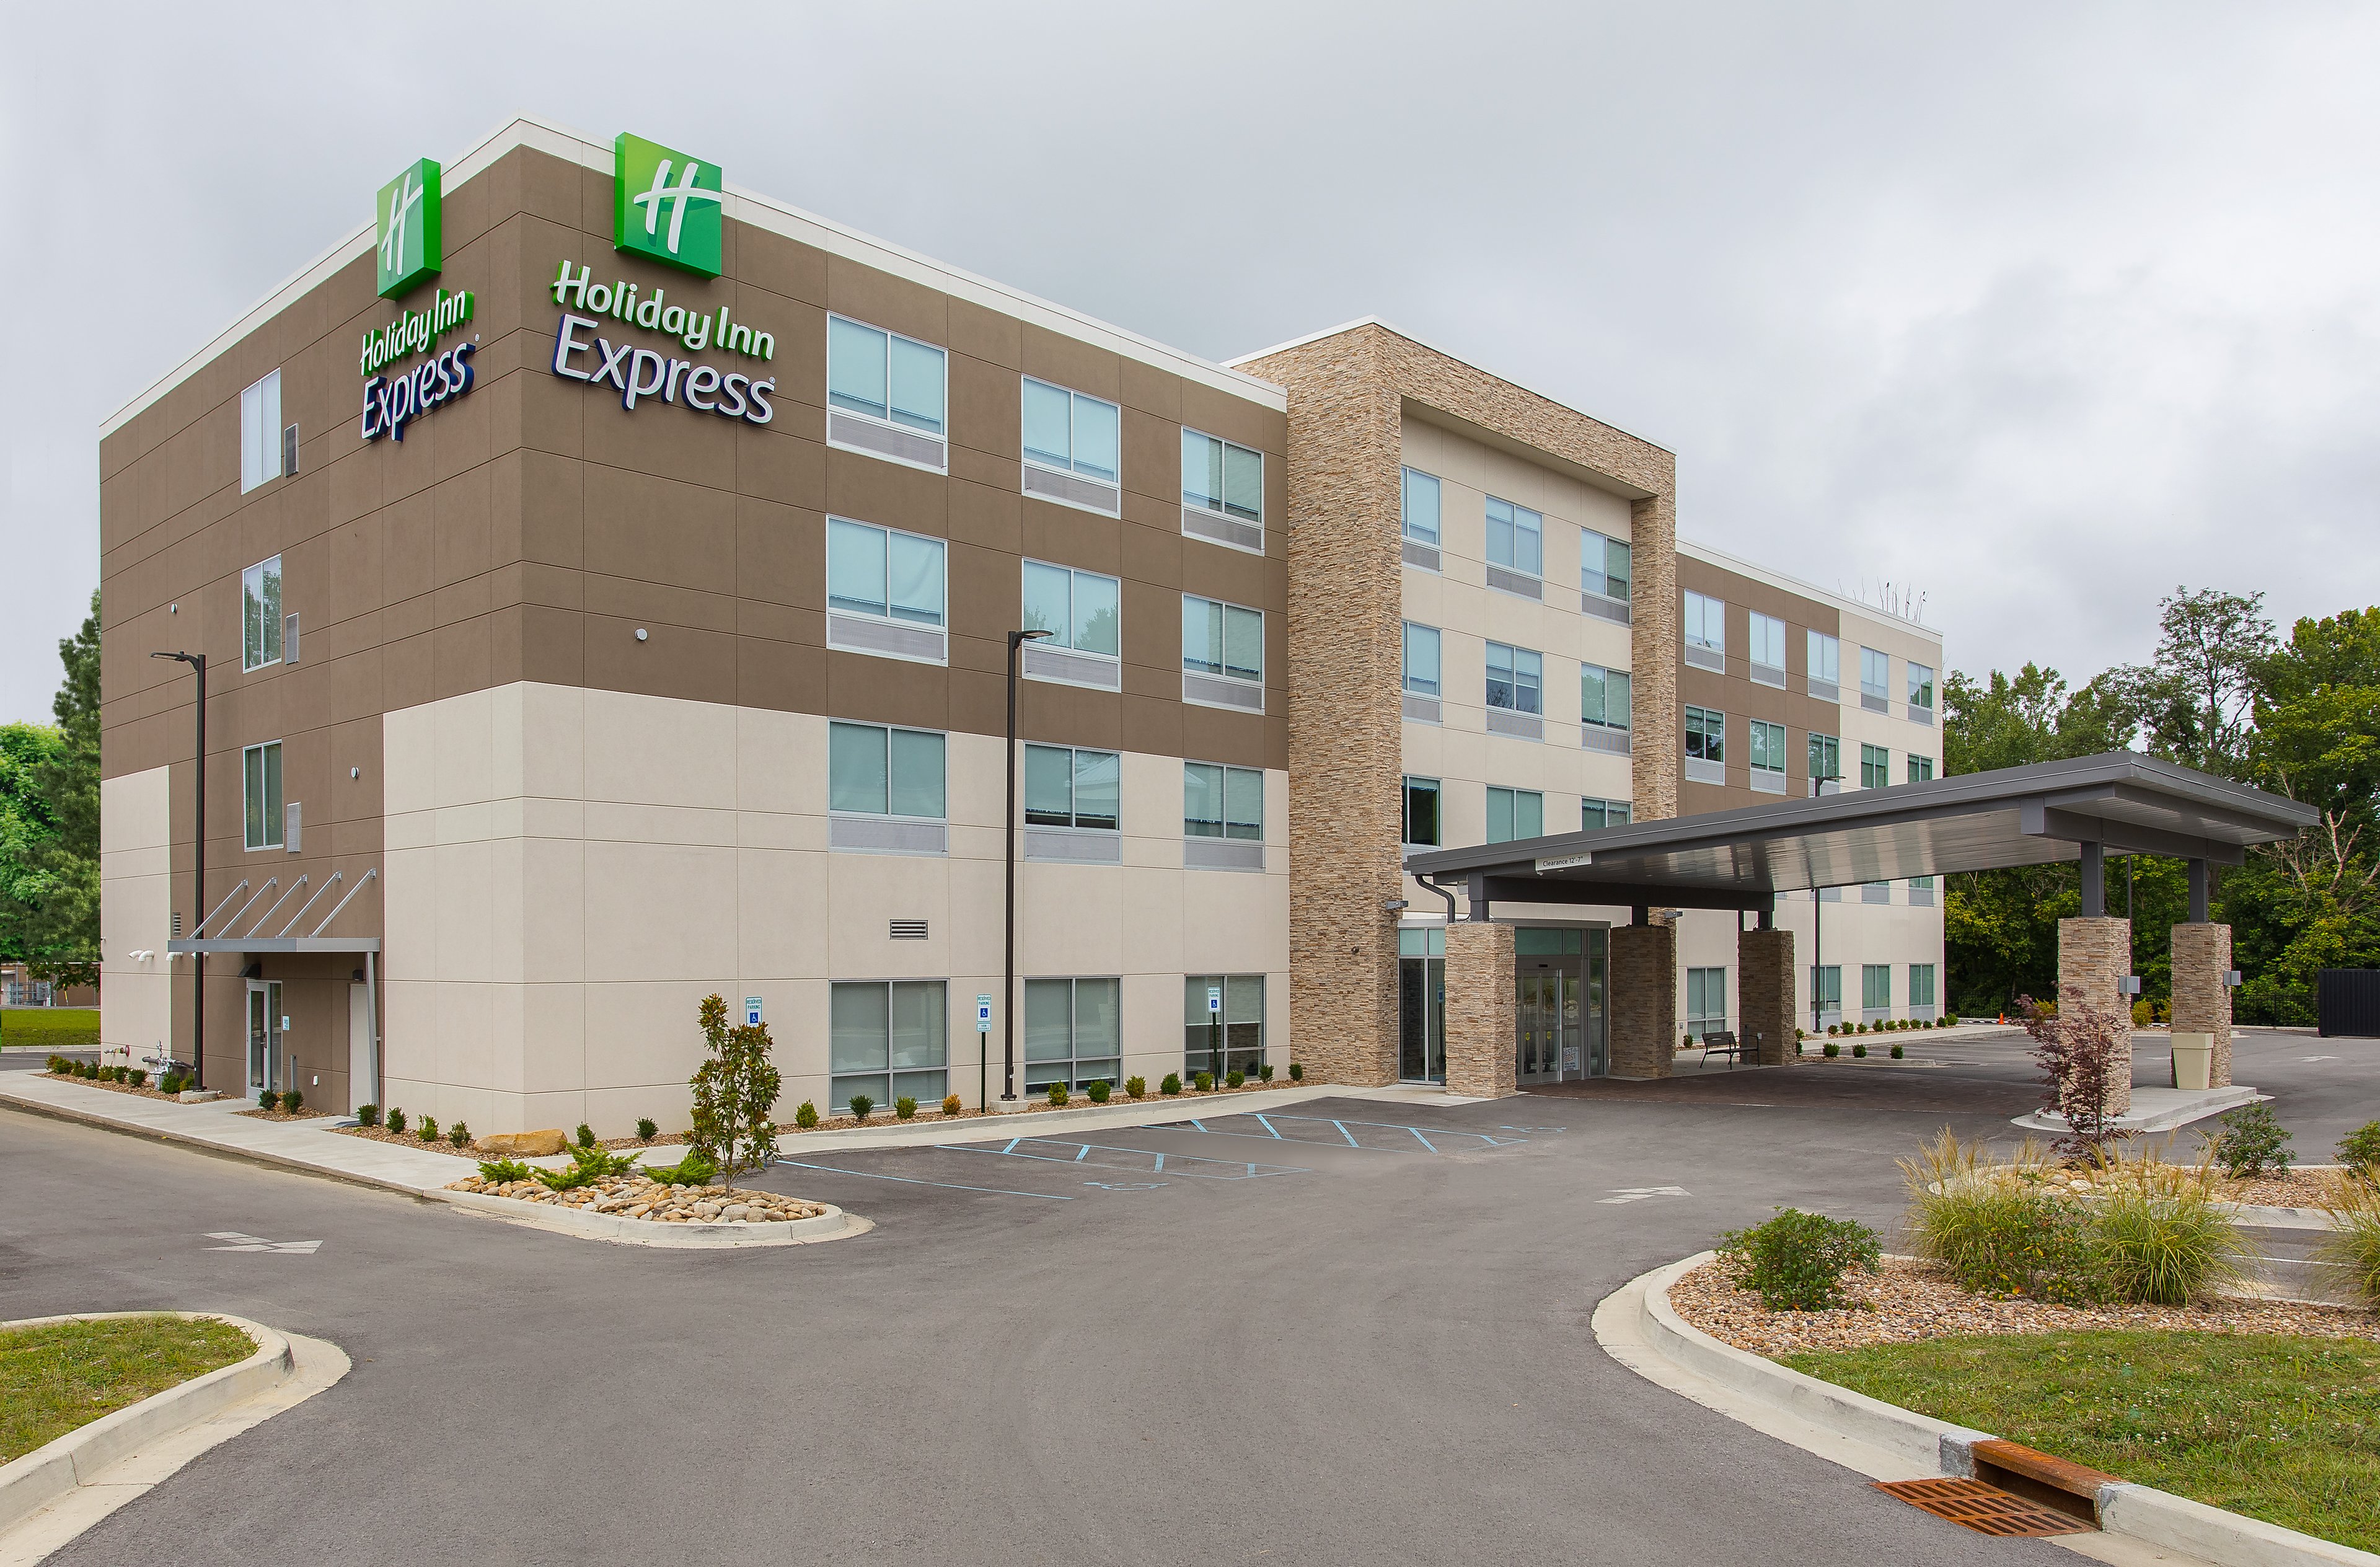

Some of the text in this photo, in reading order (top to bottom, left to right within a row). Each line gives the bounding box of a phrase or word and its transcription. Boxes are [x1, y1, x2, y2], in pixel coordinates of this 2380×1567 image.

[359, 288, 473, 377] Holiday Inn
[550, 259, 775, 361] Holiday Inn
[361, 342, 475, 441] Express
[552, 313, 775, 424] Express
